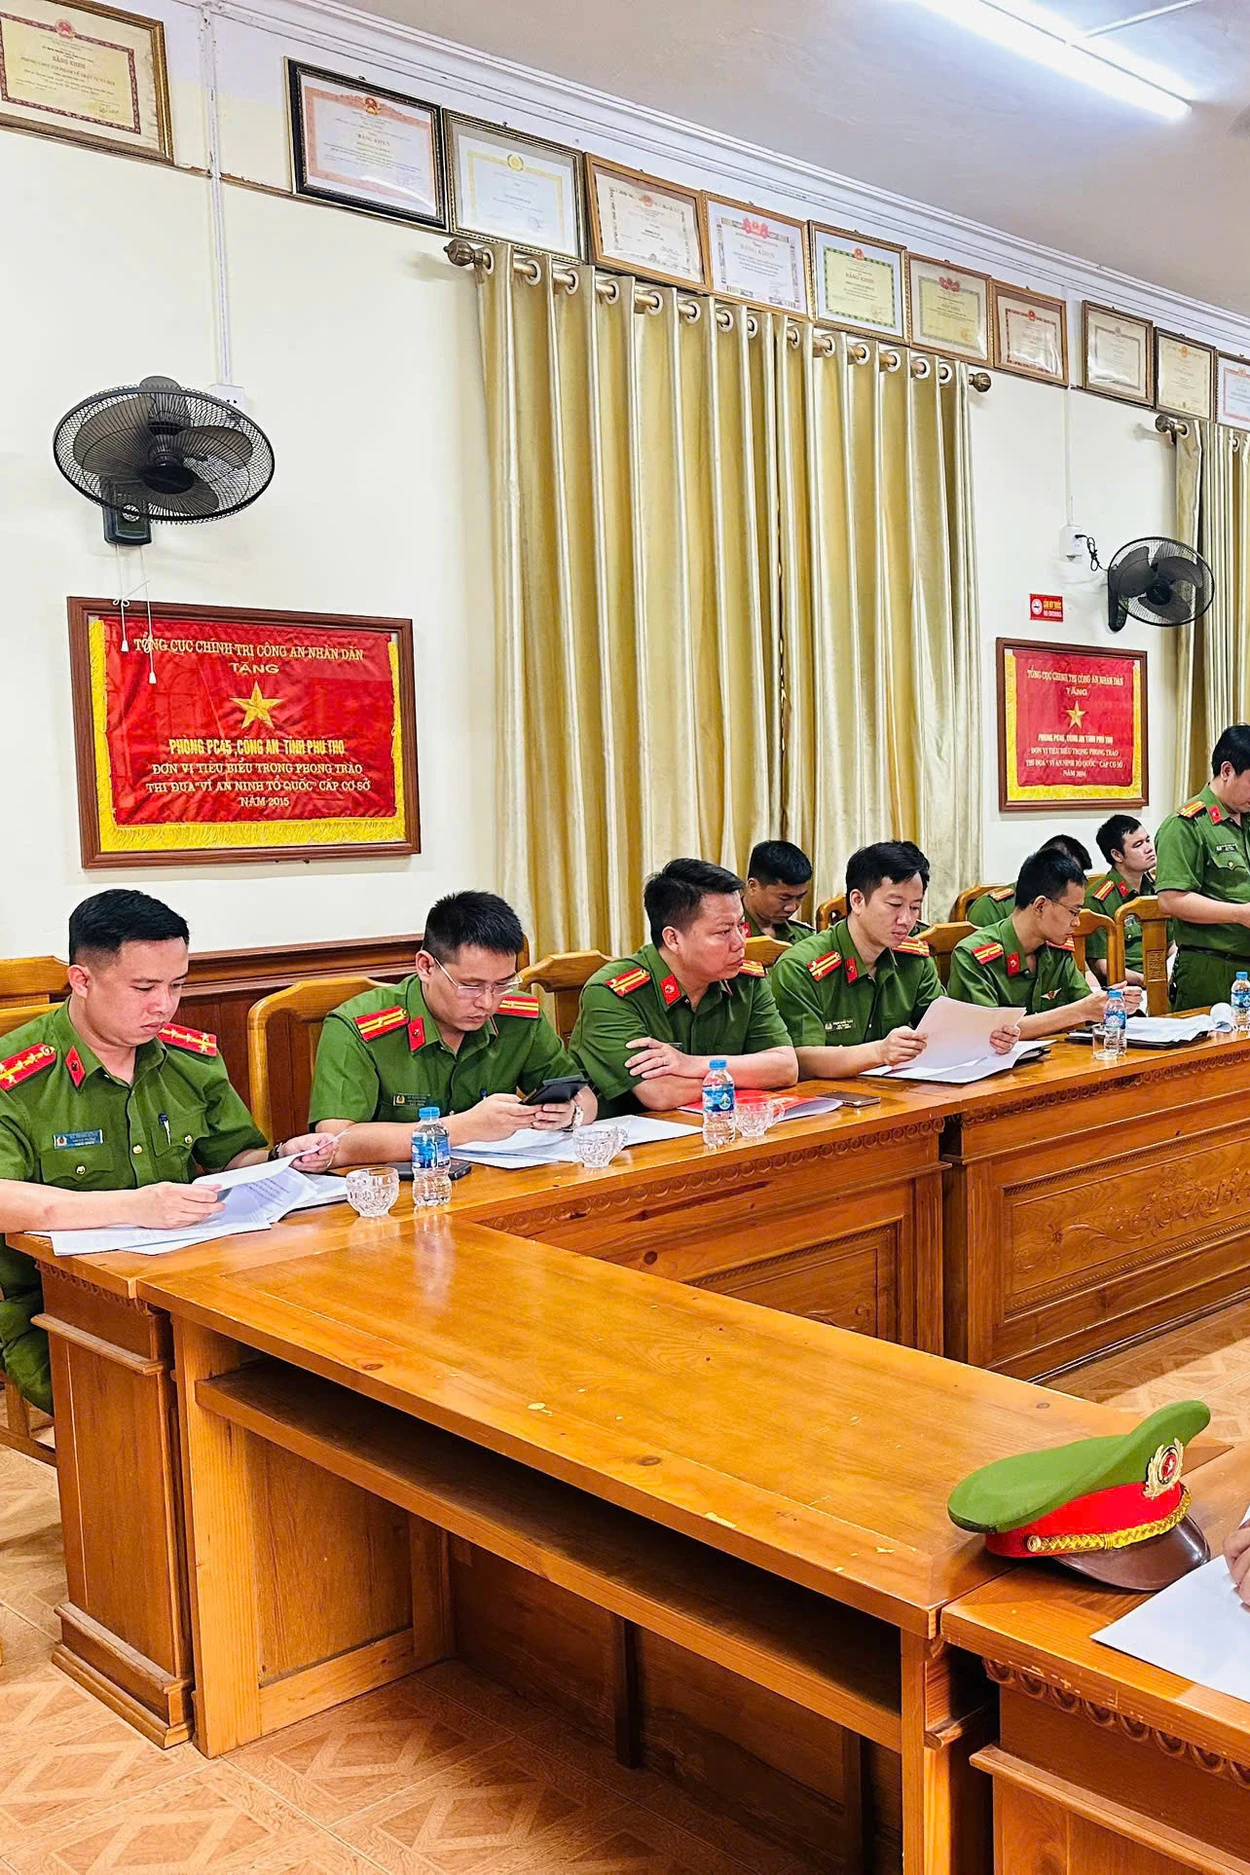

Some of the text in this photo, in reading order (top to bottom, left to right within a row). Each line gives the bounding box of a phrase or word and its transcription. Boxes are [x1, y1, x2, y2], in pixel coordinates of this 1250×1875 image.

[196, 638, 232, 655] CHÍNH
[234, 644, 254, 660] TRỊ
[257, 642, 286, 657] CÔNG
[290, 646, 306, 658] AN
[230, 661, 280, 676] TẶNG
[169, 735, 204, 755] PHÒNG
[266, 739, 279, 755] AN
[152, 762, 178, 774] ĐƠN
[196, 760, 222, 773] TIÊU
[226, 757, 253, 773] BIỂU
[256, 763, 293, 774] TRONG
[296, 763, 332, 774] PHONG
[335, 762, 362, 774] TRÀO
[146, 782, 168, 793] THI
[216, 781, 232, 792] AN
[235, 781, 264, 792] NINH
[266, 775, 281, 791] TỔ
[319, 777, 339, 791] CẤP
[342, 781, 355, 791] CƠ
[357, 776, 371, 791] SỞ
[240, 795, 290, 807] NĂM 2015
